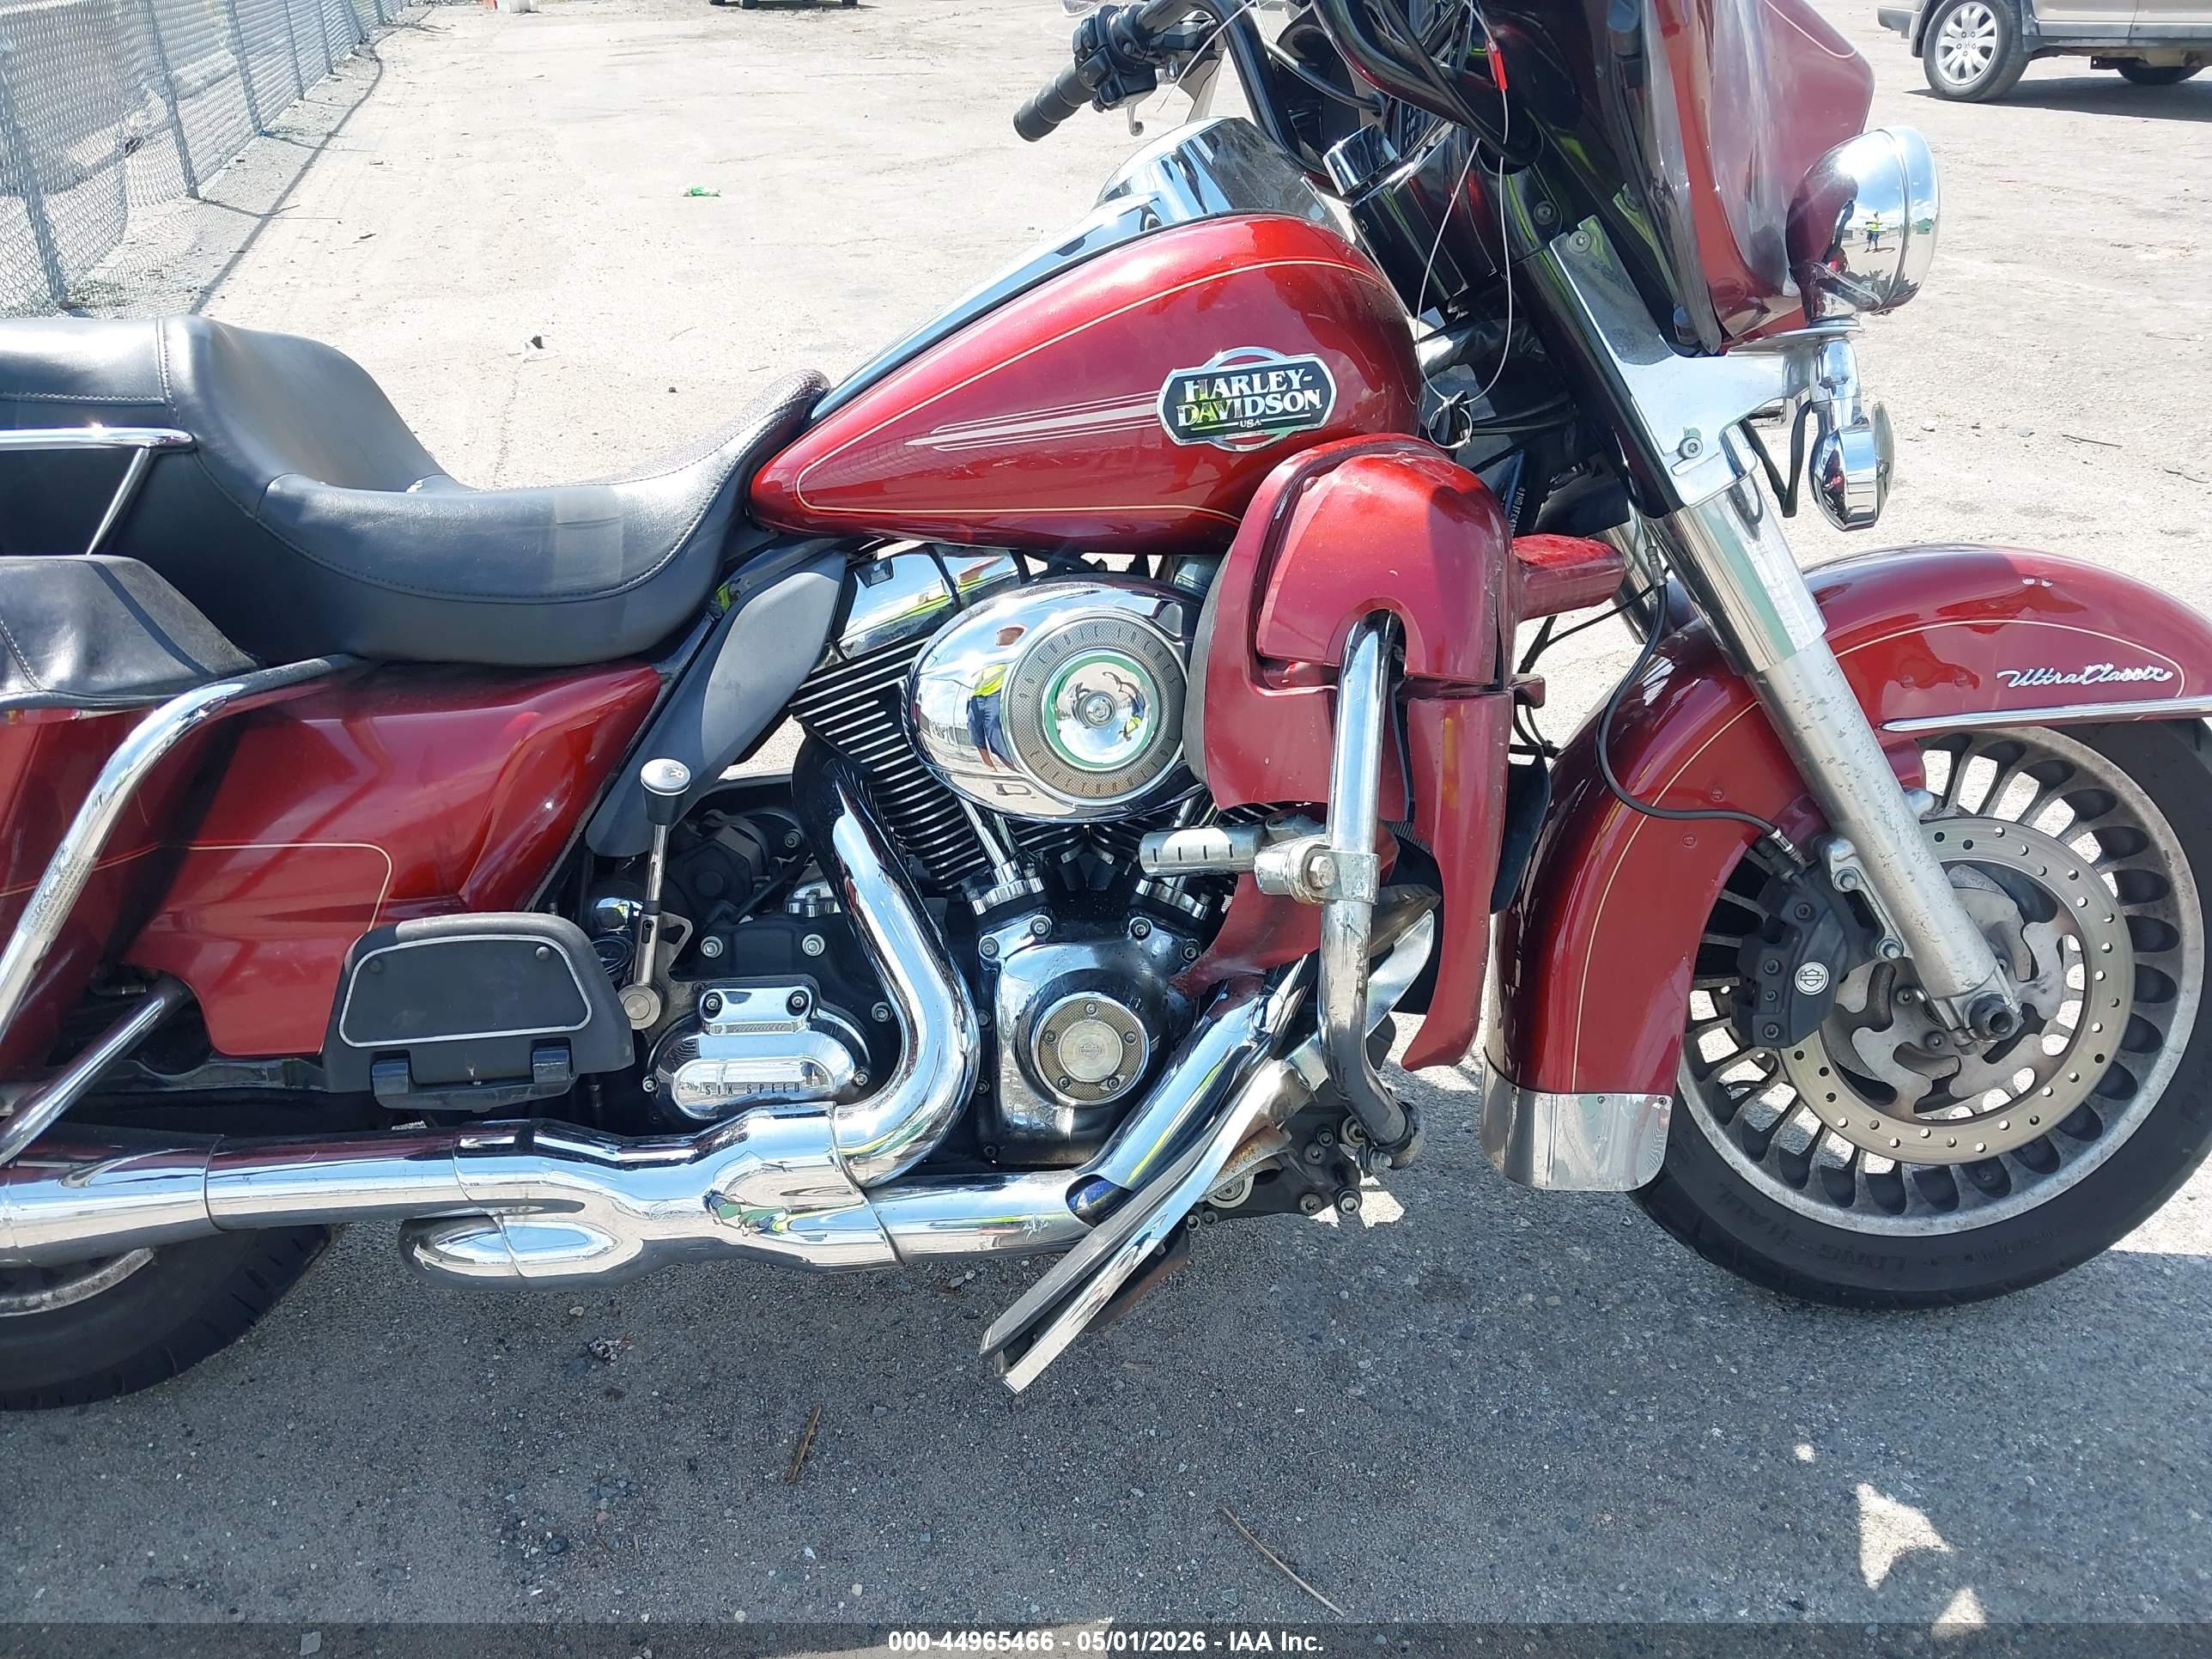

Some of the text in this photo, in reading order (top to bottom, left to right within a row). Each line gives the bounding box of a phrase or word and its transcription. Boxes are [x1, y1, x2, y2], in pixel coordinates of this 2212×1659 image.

[1183, 368, 1313, 403] HARLEY-
[1176, 389, 1322, 427] DAVIDSON
[1239, 418, 1263, 428] USA
[670, 768, 684, 779] R
[705, 1083, 800, 1096] SIX SPEED
